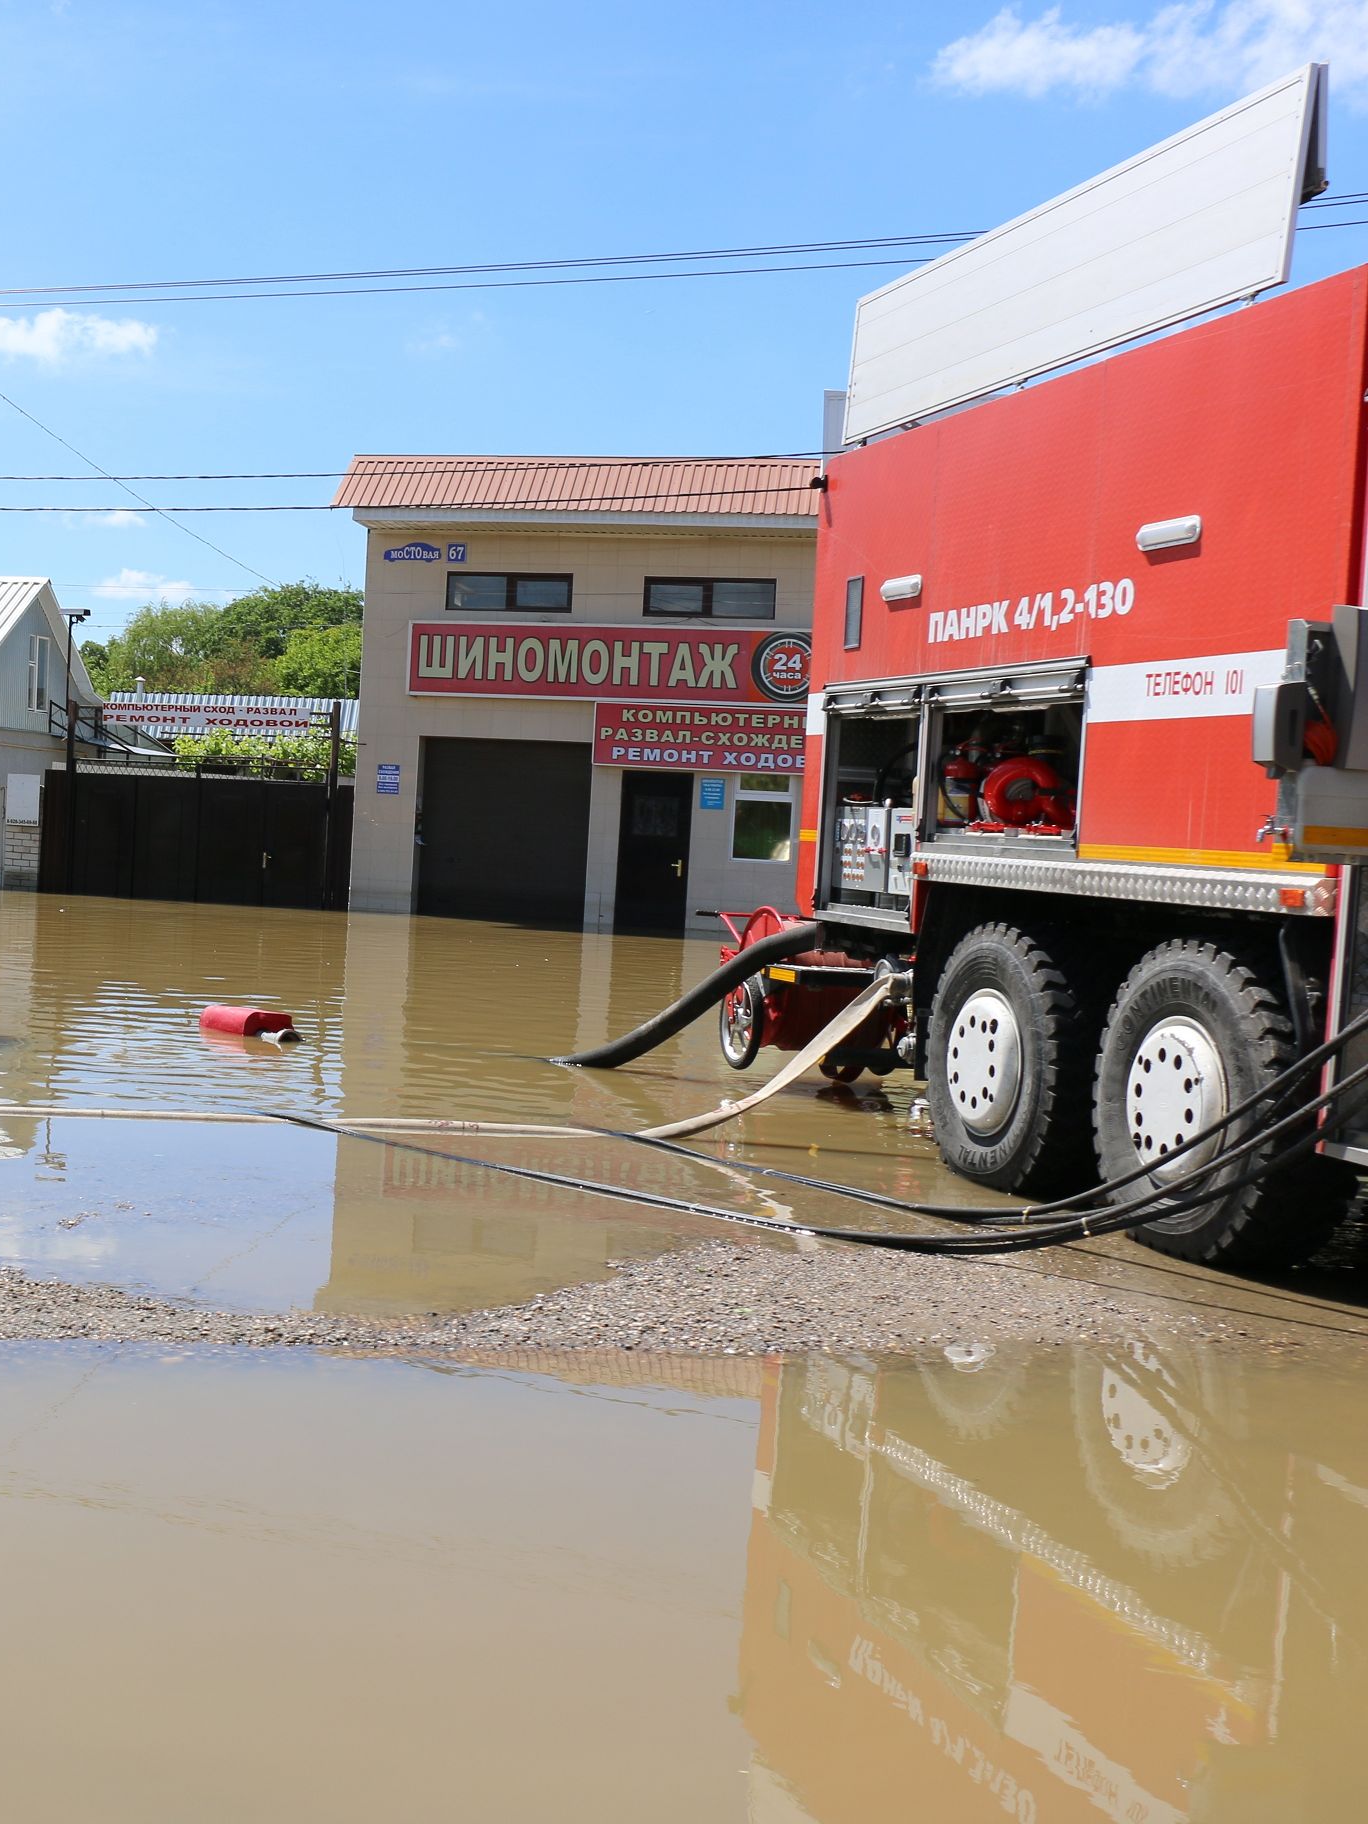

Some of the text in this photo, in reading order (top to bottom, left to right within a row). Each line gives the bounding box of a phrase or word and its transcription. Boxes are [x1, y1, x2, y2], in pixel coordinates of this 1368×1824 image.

[449, 547, 464, 560] 67
[927, 577, 1135, 644] ПАНРК 4/1,2-130
[418, 634, 739, 689] ШИНОМОНТАЖ
[773, 653, 802, 672] 24
[772, 671, 802, 681] часа
[1145, 669, 1244, 697] ТЕЛЕФОН 101
[103, 702, 201, 713] КОМПЬЮТЕРНЫЙ
[203, 706, 235, 715] СХОД
[246, 707, 297, 716] РАЗВАЛ
[103, 714, 309, 728] РЕМОНТ ХОДОВОЙ
[612, 746, 713, 765] РЕМОНТ
[1115, 976, 1218, 1053] CONTINENTAL
